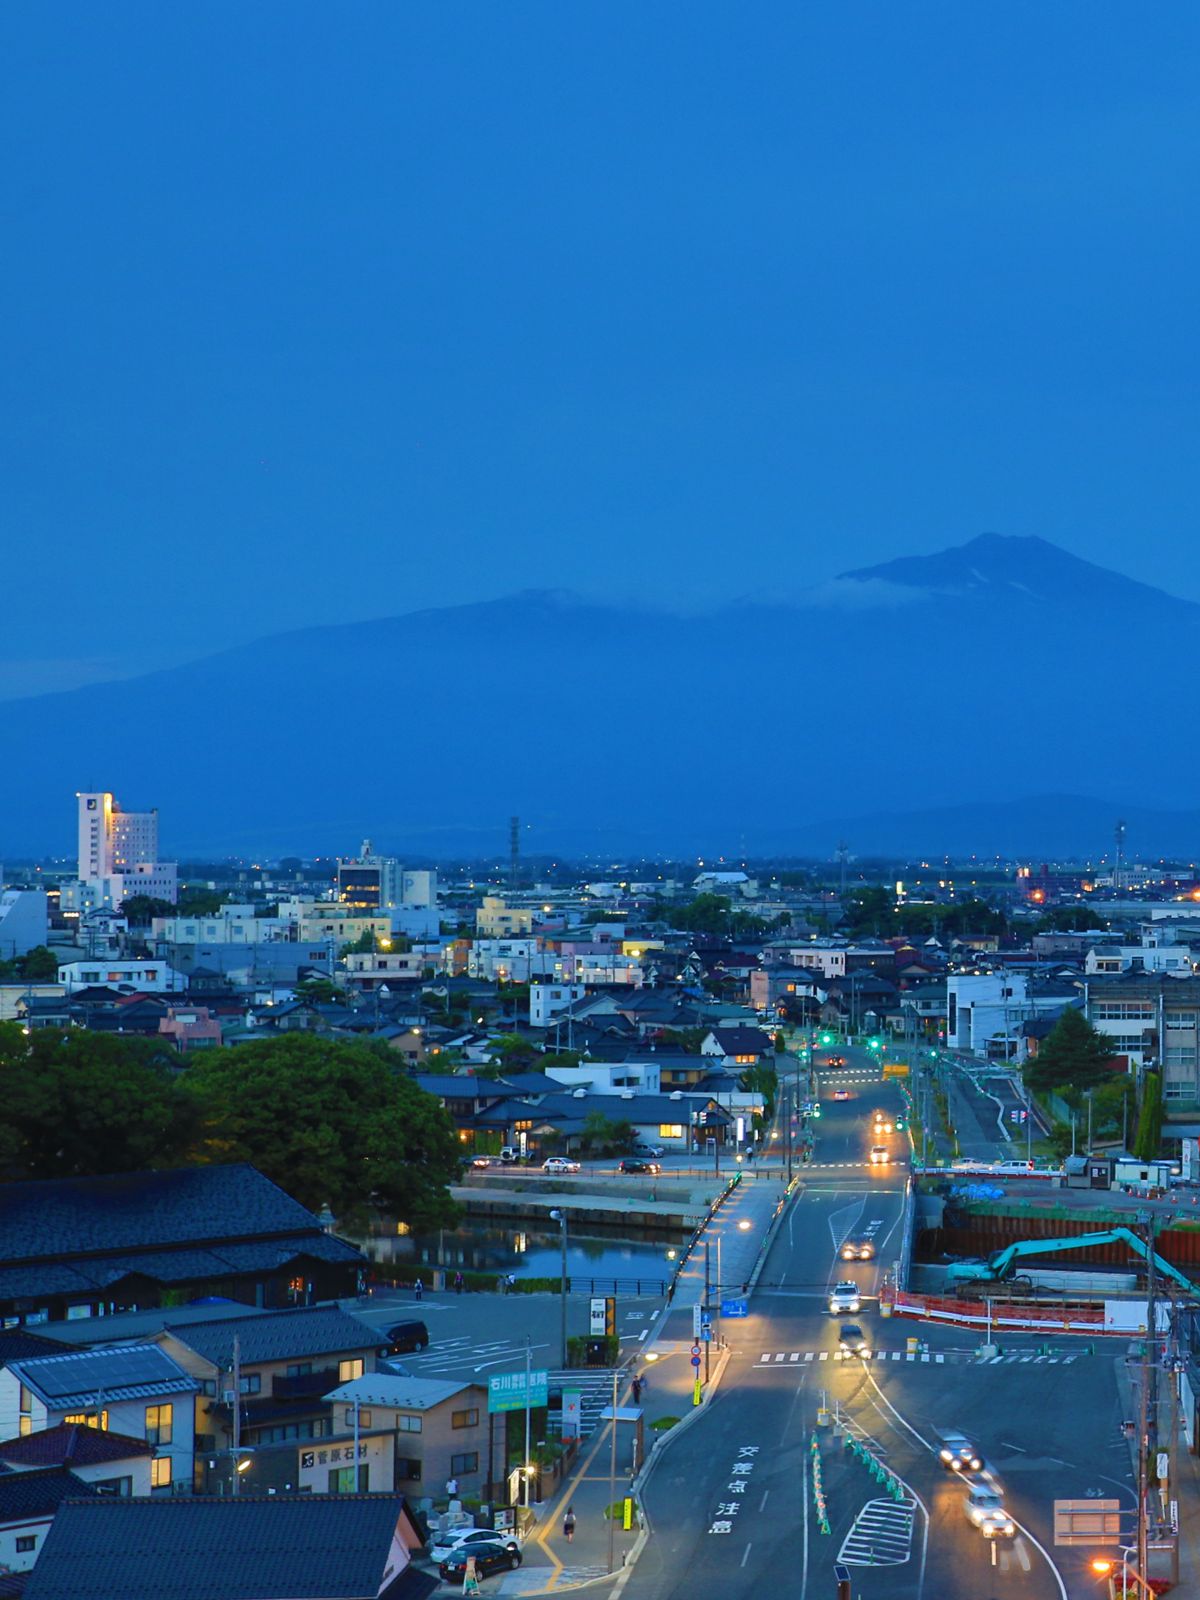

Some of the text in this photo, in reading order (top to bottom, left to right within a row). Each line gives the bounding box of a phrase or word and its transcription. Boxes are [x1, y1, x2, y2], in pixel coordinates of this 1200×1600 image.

[708, 1446, 759, 1534] 交差点注意
